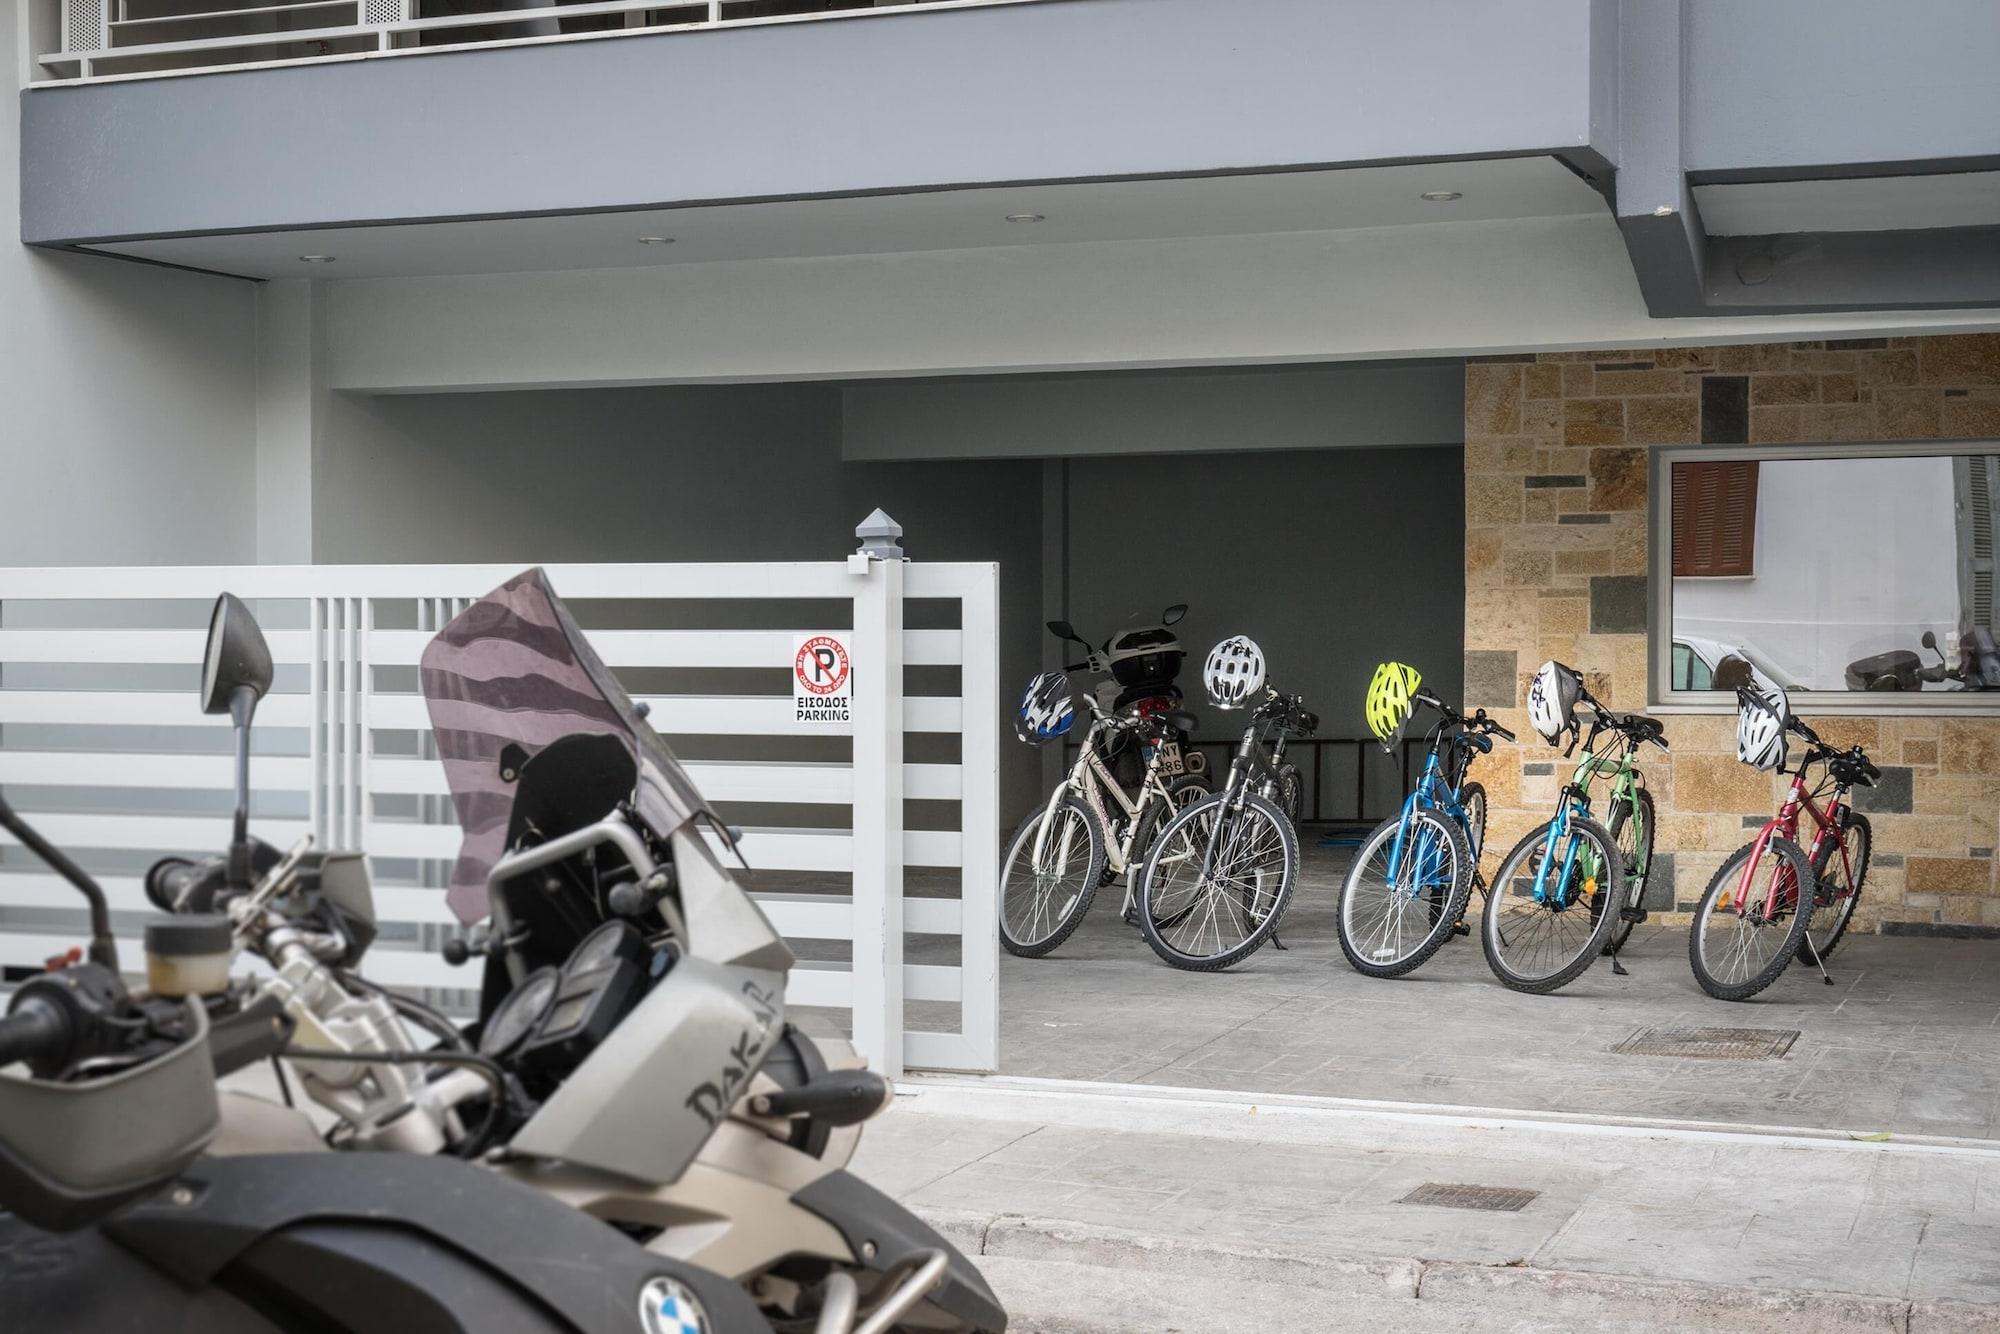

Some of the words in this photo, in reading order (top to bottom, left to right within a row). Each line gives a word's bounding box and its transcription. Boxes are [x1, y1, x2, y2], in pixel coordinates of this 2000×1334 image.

[815, 649, 835, 682] P
[797, 697, 848, 708] ΕΙΣΟΔΟΣ
[796, 710, 849, 721] PARKING
[1159, 745, 1177, 758] NY
[684, 980, 778, 1131] DAKAR
